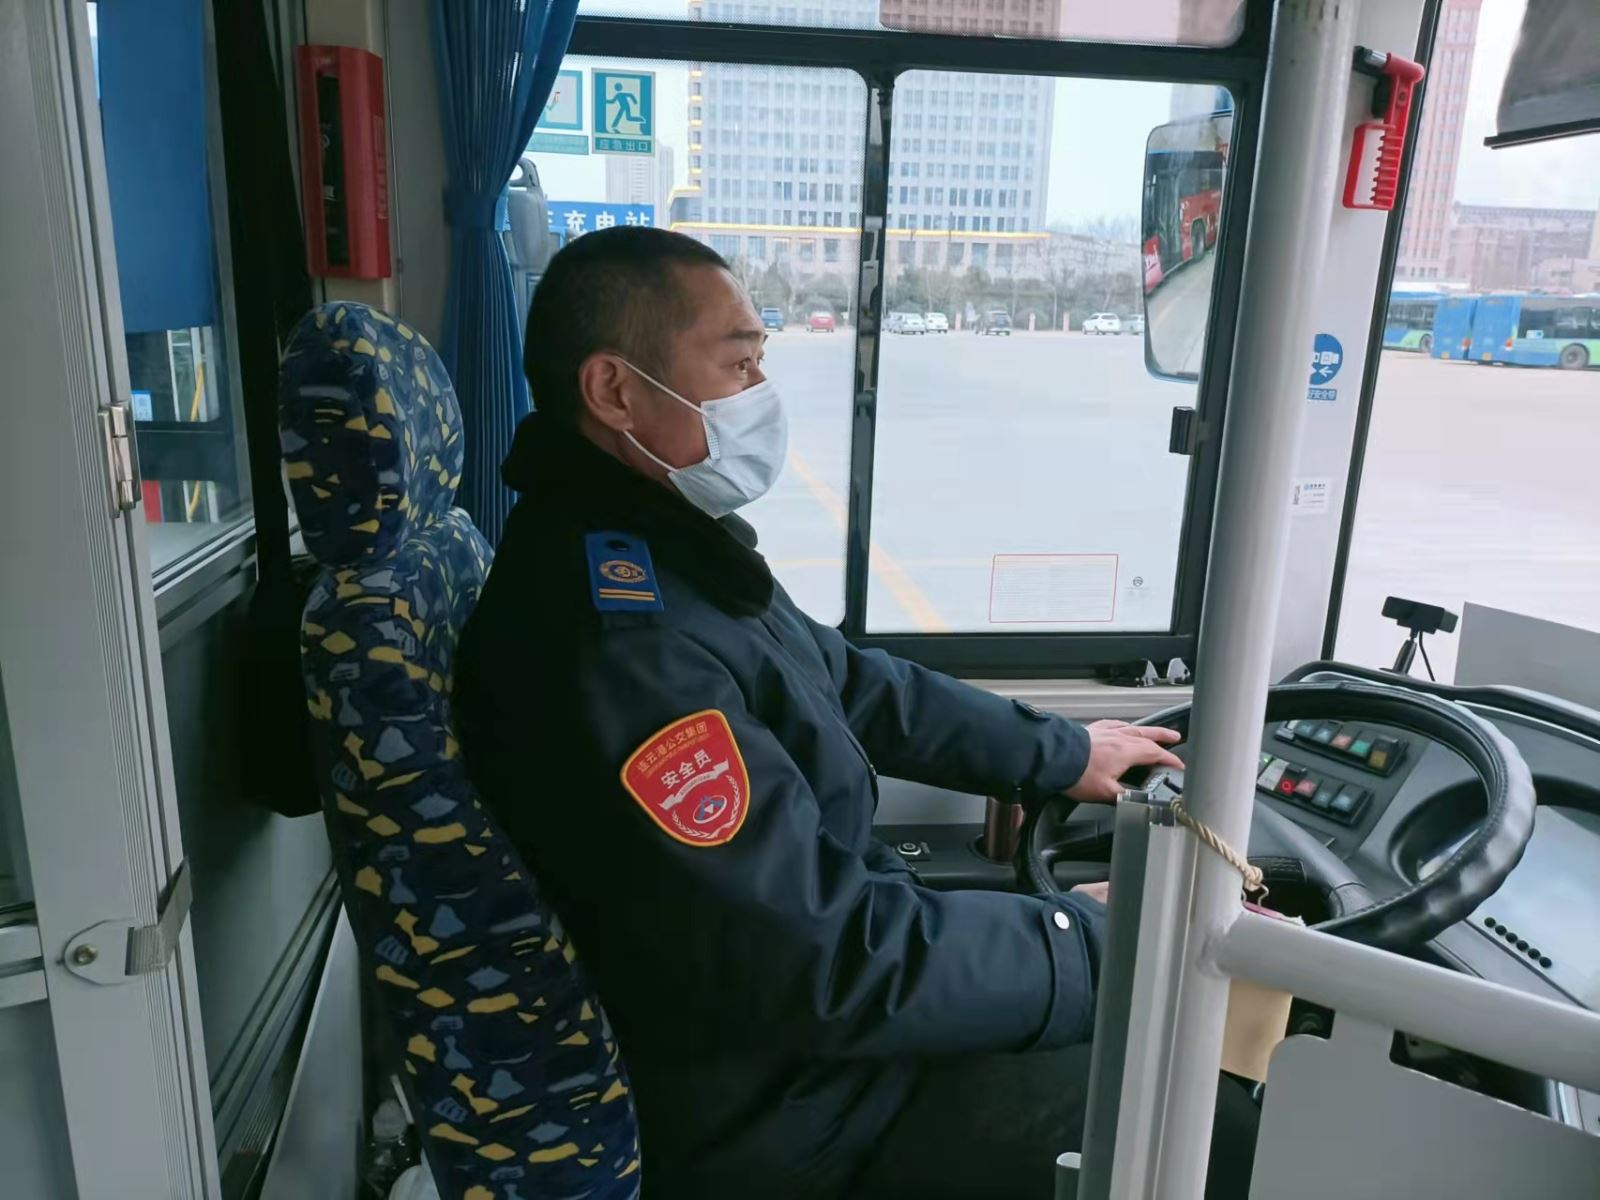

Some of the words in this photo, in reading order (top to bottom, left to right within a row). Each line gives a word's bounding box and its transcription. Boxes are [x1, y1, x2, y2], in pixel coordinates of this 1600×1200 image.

[547, 210, 650, 234] 充电站
[660, 749, 712, 789] 安全员
